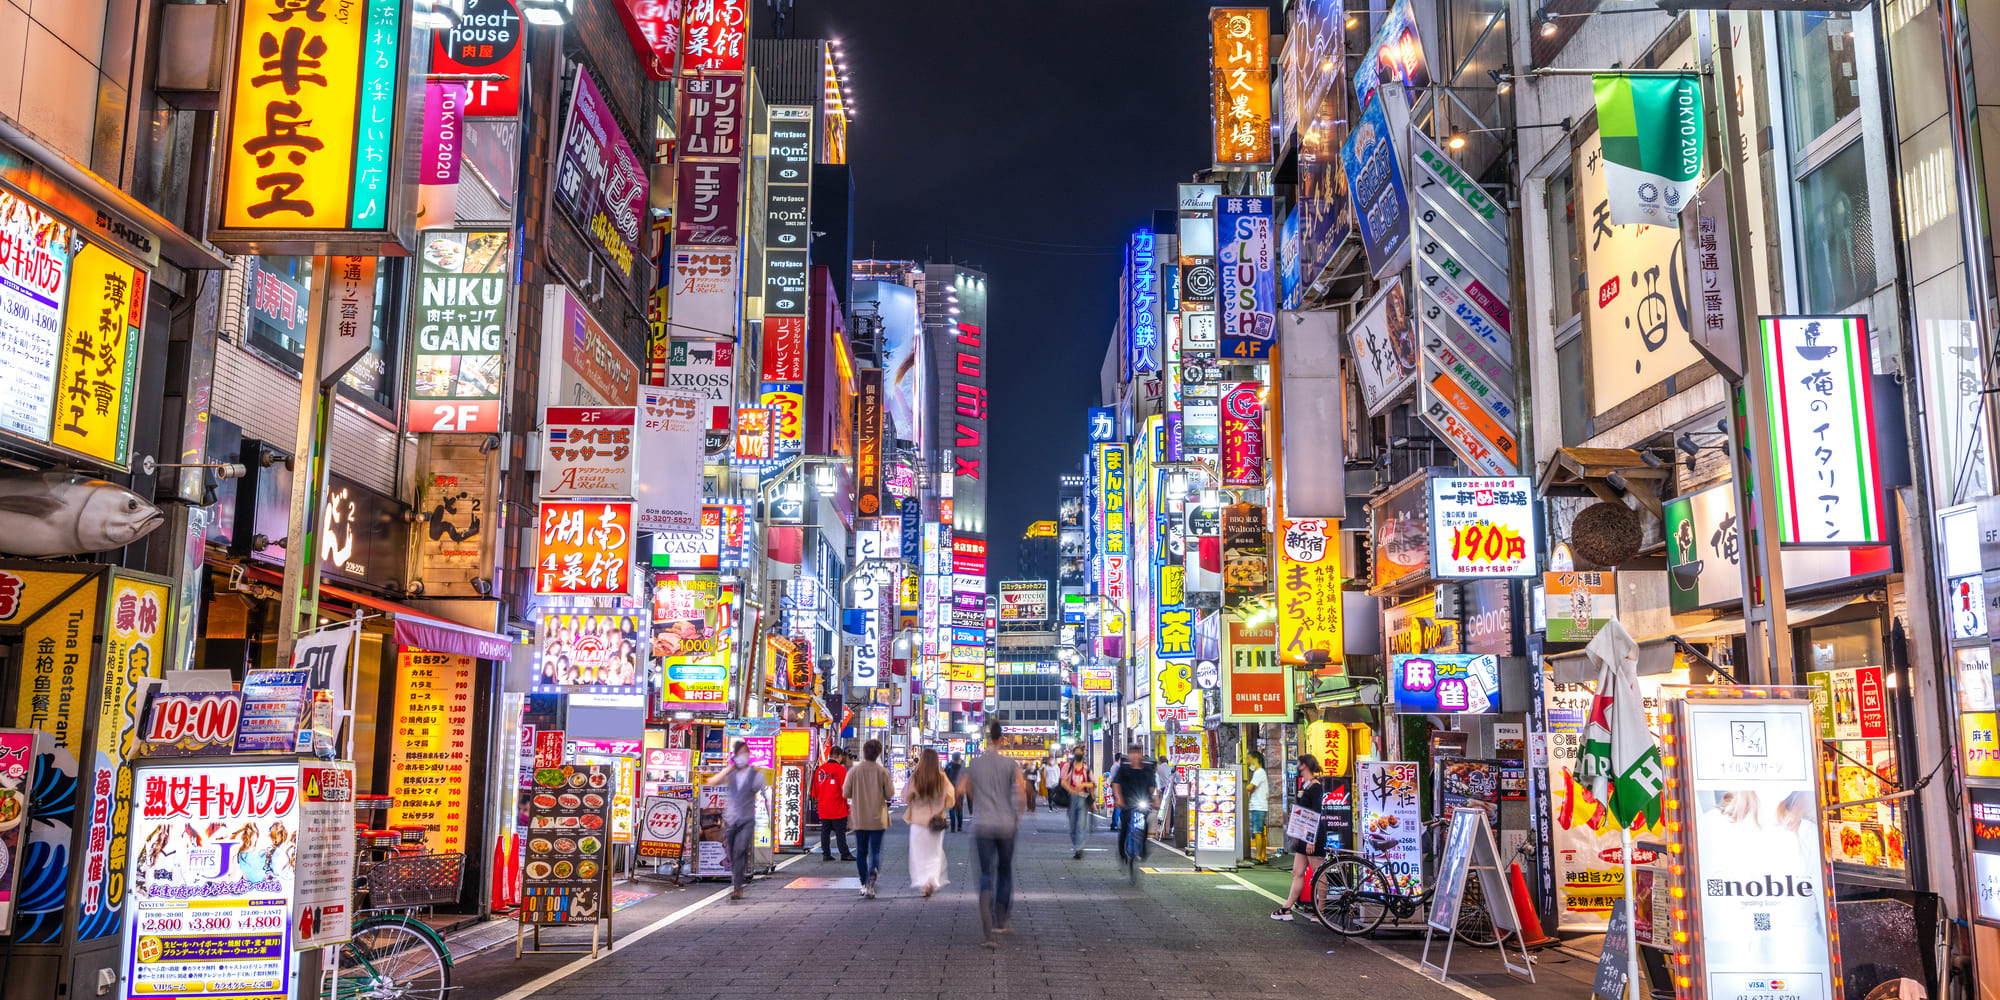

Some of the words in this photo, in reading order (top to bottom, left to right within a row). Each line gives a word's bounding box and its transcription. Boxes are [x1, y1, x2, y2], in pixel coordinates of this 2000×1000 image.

[463, 11, 513, 27] meat
[462, 44, 493, 59] 肉屋
[690, 79, 713, 93] 3F
[1228, 41, 1256, 147] 山久農場
[440, 91, 456, 139] TOKYO
[713, 79, 737, 154] レンタル
[1678, 86, 1695, 136] TOKYO
[687, 98, 710, 154] ルーム
[436, 143, 453, 180] 2020
[1681, 137, 1698, 175] 2020
[1356, 137, 1393, 209] GREAT
[1420, 177, 1435, 189] 7
[693, 165, 720, 224] エデン
[1227, 199, 1263, 214] 麻雀
[1367, 183, 1400, 245] BLUE
[1423, 209, 1437, 223] 6
[688, 225, 733, 244] Eden
[782, 234, 792, 242] 4F
[1424, 242, 1438, 255] 5
[690, 254, 732, 266] タイ古式
[677, 266, 731, 277] マッサージ
[1698, 216, 1725, 331] 劇場通り一番街
[422, 277, 504, 307] NIKU
[1225, 267, 1237, 333] エスラッシュ
[1132, 229, 1158, 373] カラオケの鉄人
[427, 309, 497, 322] 肉ギャング
[1425, 275, 1440, 287] 4
[1456, 303, 1497, 344] センチュリー
[1427, 306, 1441, 320] 3
[419, 324, 501, 350] GANG
[674, 345, 685, 356] 肉
[776, 318, 790, 380] リフレッシュ
[1234, 341, 1261, 357] 4F
[1427, 338, 1442, 353] 2
[1439, 348, 1458, 366] TV
[671, 373, 729, 387] XROSS
[1221, 383, 1234, 392] 3F
[658, 397, 696, 410] タイ古式
[432, 405, 479, 431] 2F
[581, 412, 601, 422] 2F
[646, 407, 696, 419] マッサージ
[1428, 402, 1448, 422] B1
[646, 420, 659, 428] 2F
[569, 428, 630, 444] タイ古式
[864, 384, 876, 487] 個室ダイニング居酒屋
[781, 439, 801, 449] 天神
[1231, 420, 1245, 479] カリーナ
[549, 447, 630, 462] マッサージ
[1800, 369, 1840, 540] 俺のイタリアン
[435, 475, 458, 487] 焼肉
[471, 498, 481, 511] 2
[1106, 451, 1123, 553] まんが喫茶
[1440, 489, 1527, 507] 一軒め酒場
[544, 504, 626, 550] 湖南
[640, 514, 693, 525] 03-3207-5527
[903, 501, 918, 554] カラオケ
[1228, 524, 1261, 533] Walton's
[1985, 530, 1997, 543] 5F
[664, 541, 709, 554] CASA
[953, 542, 985, 554] 全店営業中
[1287, 531, 1323, 552] 新宿
[1451, 526, 1527, 561] 190円
[1300, 551, 1312, 561] の
[908, 575, 918, 602] 麻雀
[1286, 564, 1315, 655] まっちゃん
[1327, 605, 1337, 633] 水炊き
[66, 609, 84, 649] Tuna
[1239, 629, 1258, 637] OPEN
[1259, 628, 1273, 637] 24h
[118, 641, 127, 673] Tuna
[413, 655, 450, 665] ねぎタン
[411, 669, 433, 677] カルビ
[952, 668, 973, 678] ゲーム
[1437, 663, 1467, 676] フリー
[1966, 660, 1989, 671] noble
[30, 637, 56, 730] 金枪鱼餐厅
[410, 681, 432, 689] ハラミ
[54, 653, 79, 749] Restaurant
[684, 691, 723, 700] 受付3F
[1235, 693, 1261, 702] ONLINE
[1263, 693, 1280, 701] CAFE
[1865, 696, 1877, 706] OK
[108, 677, 124, 754] Restaurant
[1157, 707, 1197, 720] マンボー
[1254, 704, 1263, 712] B1
[151, 699, 238, 741] 19:00
[1972, 729, 1993, 742] 麻雀
[1324, 729, 1340, 777] 鉄なべ餃子
[1968, 748, 2000, 760] クアトロ
[1395, 766, 1415, 781] 3F
[144, 774, 296, 818] 熟女キャバクラ
[784, 768, 801, 842] 無料案内所
[640, 848, 680, 858] COFFEE
[1724, 875, 1813, 897] noble
[142, 918, 182, 932] ¥2,800
[189, 917, 231, 932] ¥3,800
[238, 915, 281, 931] ¥4,800
